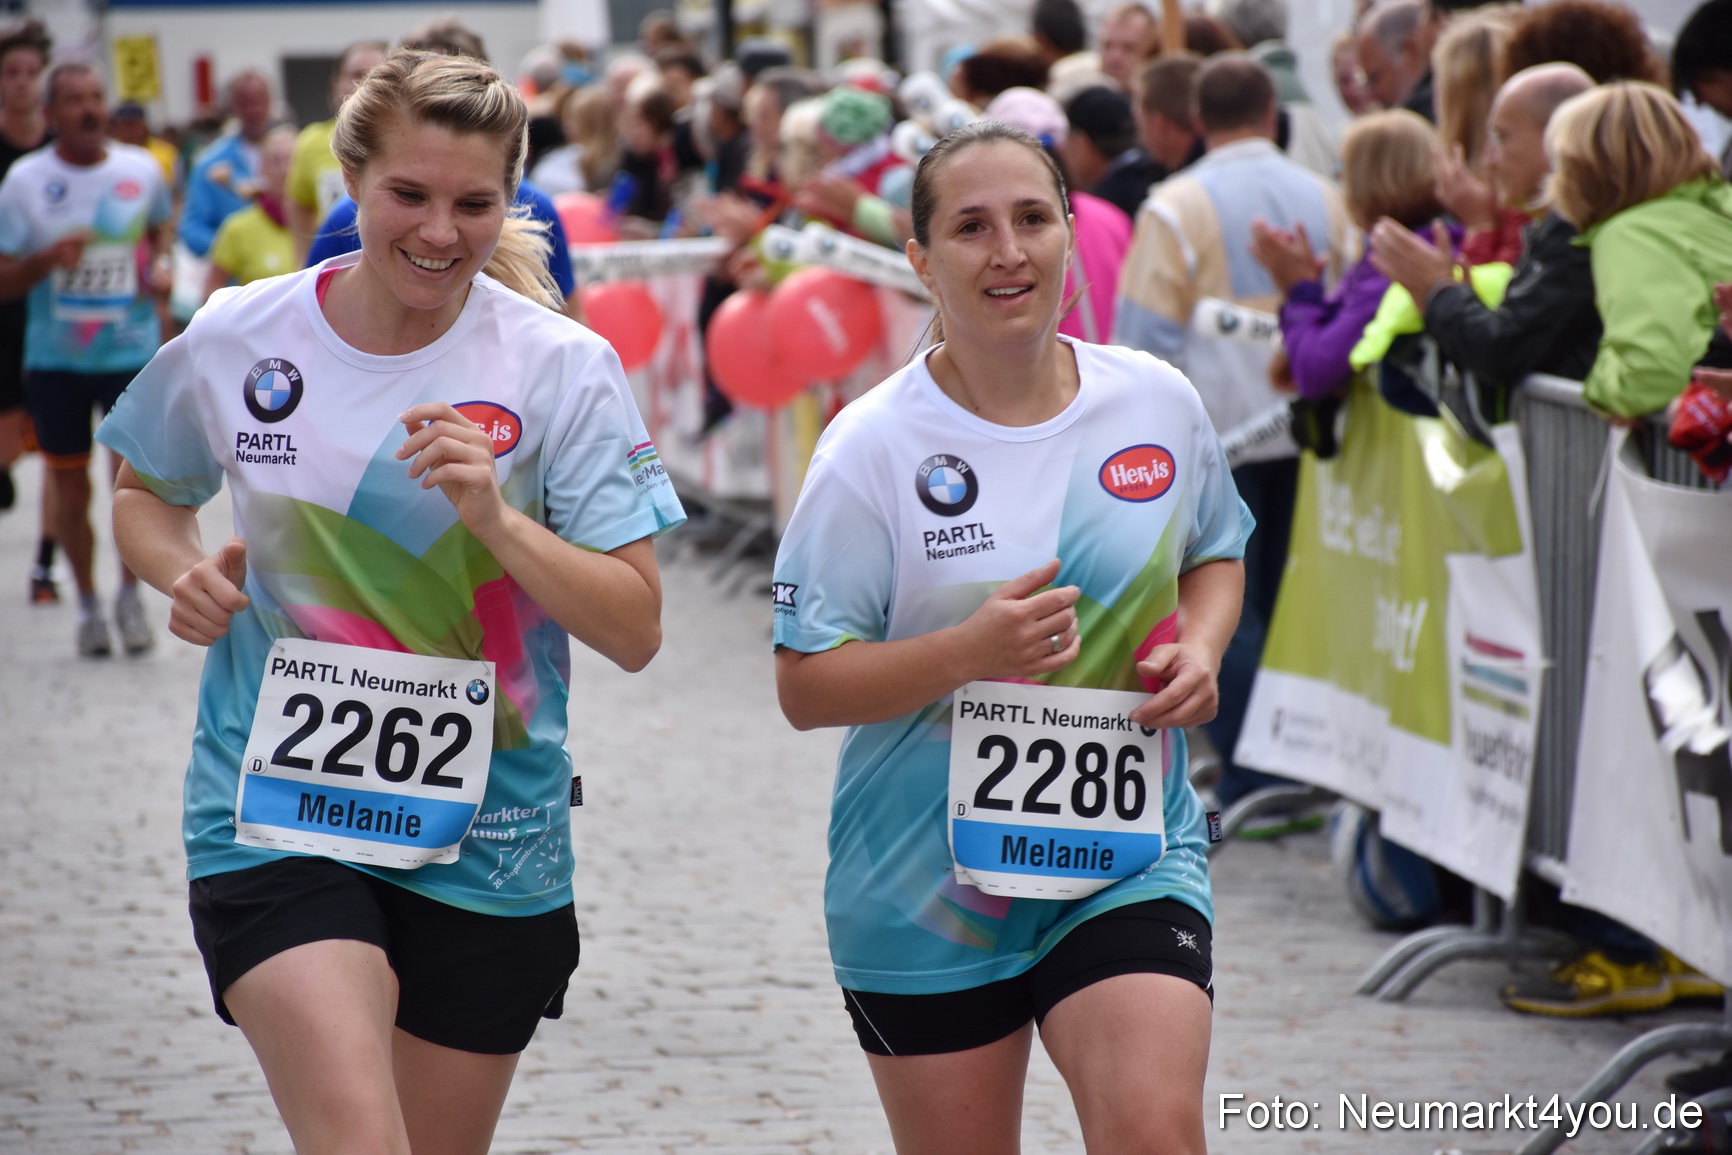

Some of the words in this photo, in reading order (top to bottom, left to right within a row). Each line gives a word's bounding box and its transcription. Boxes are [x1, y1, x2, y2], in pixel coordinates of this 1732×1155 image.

[251, 359, 300, 382] BMW
[236, 432, 297, 452] PARTL
[236, 450, 297, 465] Neumarkt
[919, 455, 970, 477] BMW
[1109, 458, 1169, 487] Hervis
[923, 522, 993, 548] PARTL
[926, 539, 996, 561] Neumarkt
[270, 657, 345, 685] PARTL
[350, 668, 457, 699] Neumarkt
[960, 700, 1035, 725] PARTL
[1041, 708, 1133, 732] Neumarkt
[270, 692, 473, 789] 2262
[252, 758, 262, 773] D
[973, 734, 1146, 821] 2286
[297, 792, 422, 838] Melanie
[957, 803, 966, 816] D
[493, 877, 505, 889] 20.
[503, 842, 538, 880] September
[1001, 835, 1115, 871] Melanie
